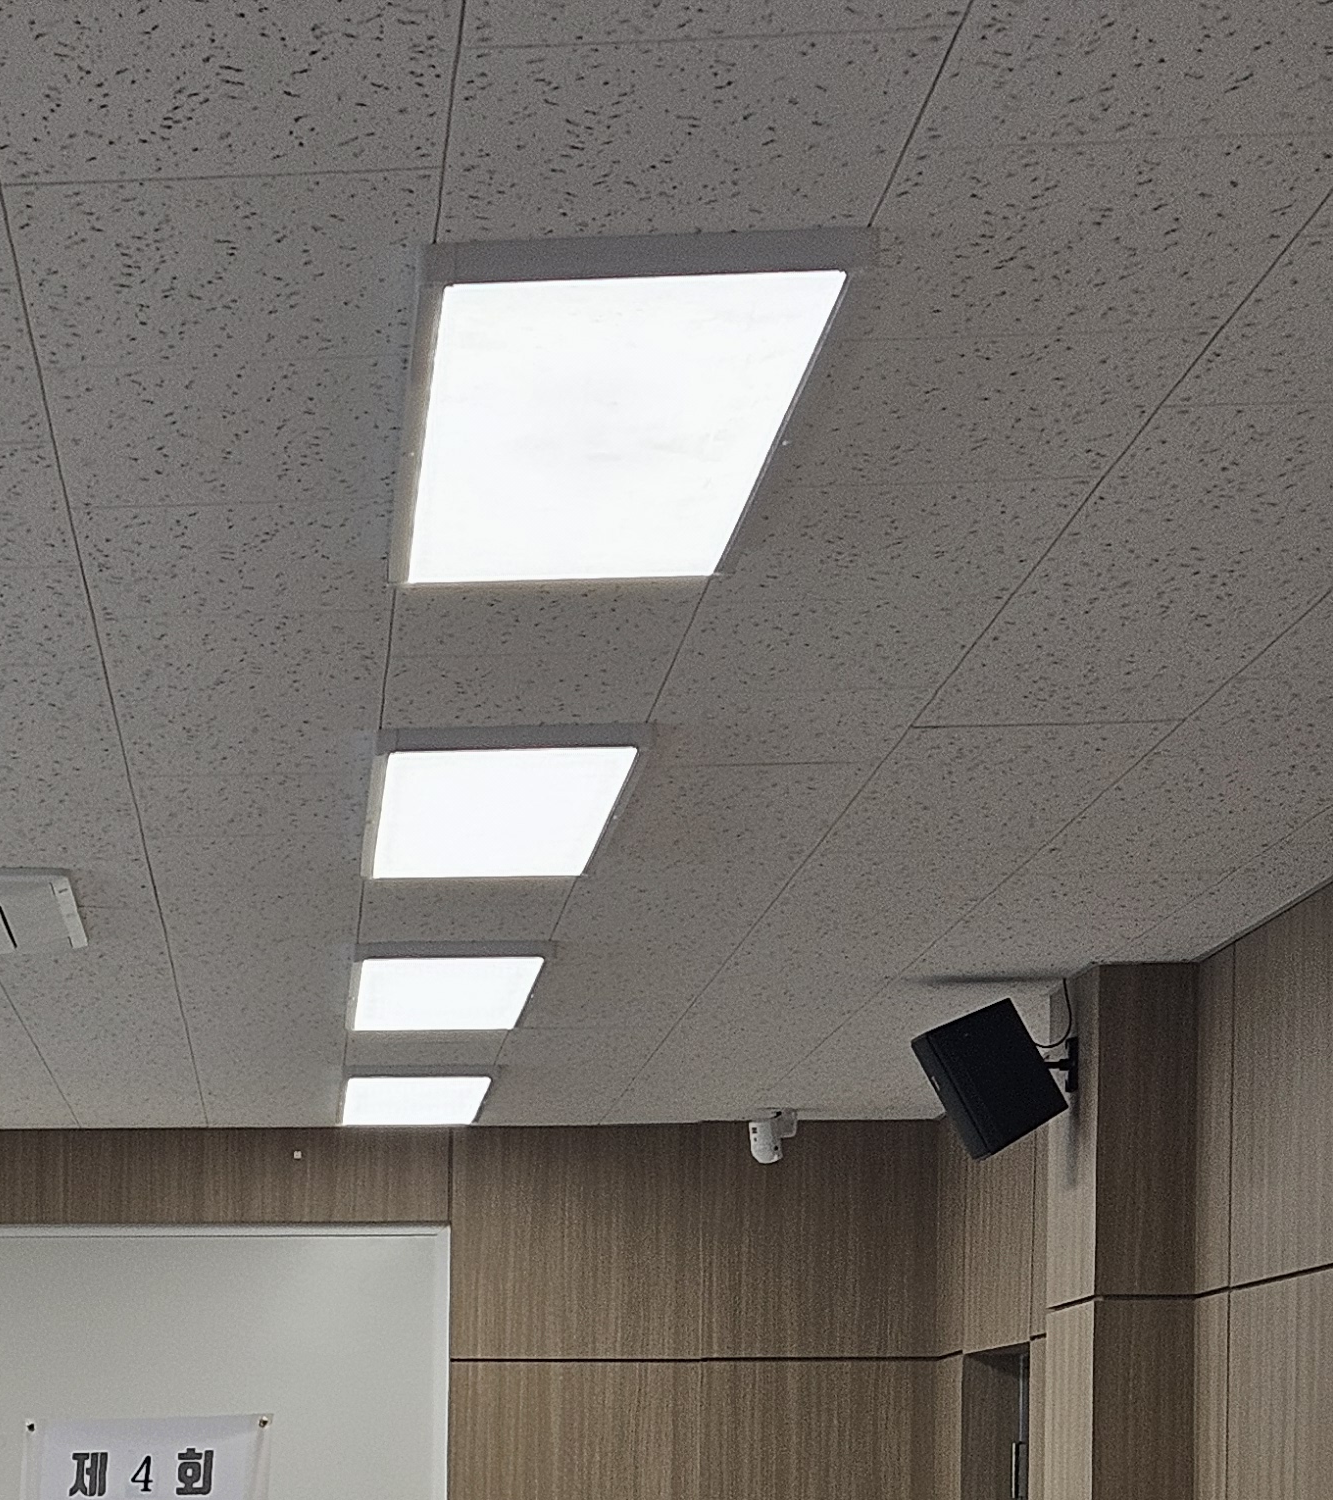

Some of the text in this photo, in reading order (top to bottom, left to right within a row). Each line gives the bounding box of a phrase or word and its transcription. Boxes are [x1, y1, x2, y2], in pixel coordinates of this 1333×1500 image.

[69, 1447, 215, 1497] 제 4 회
